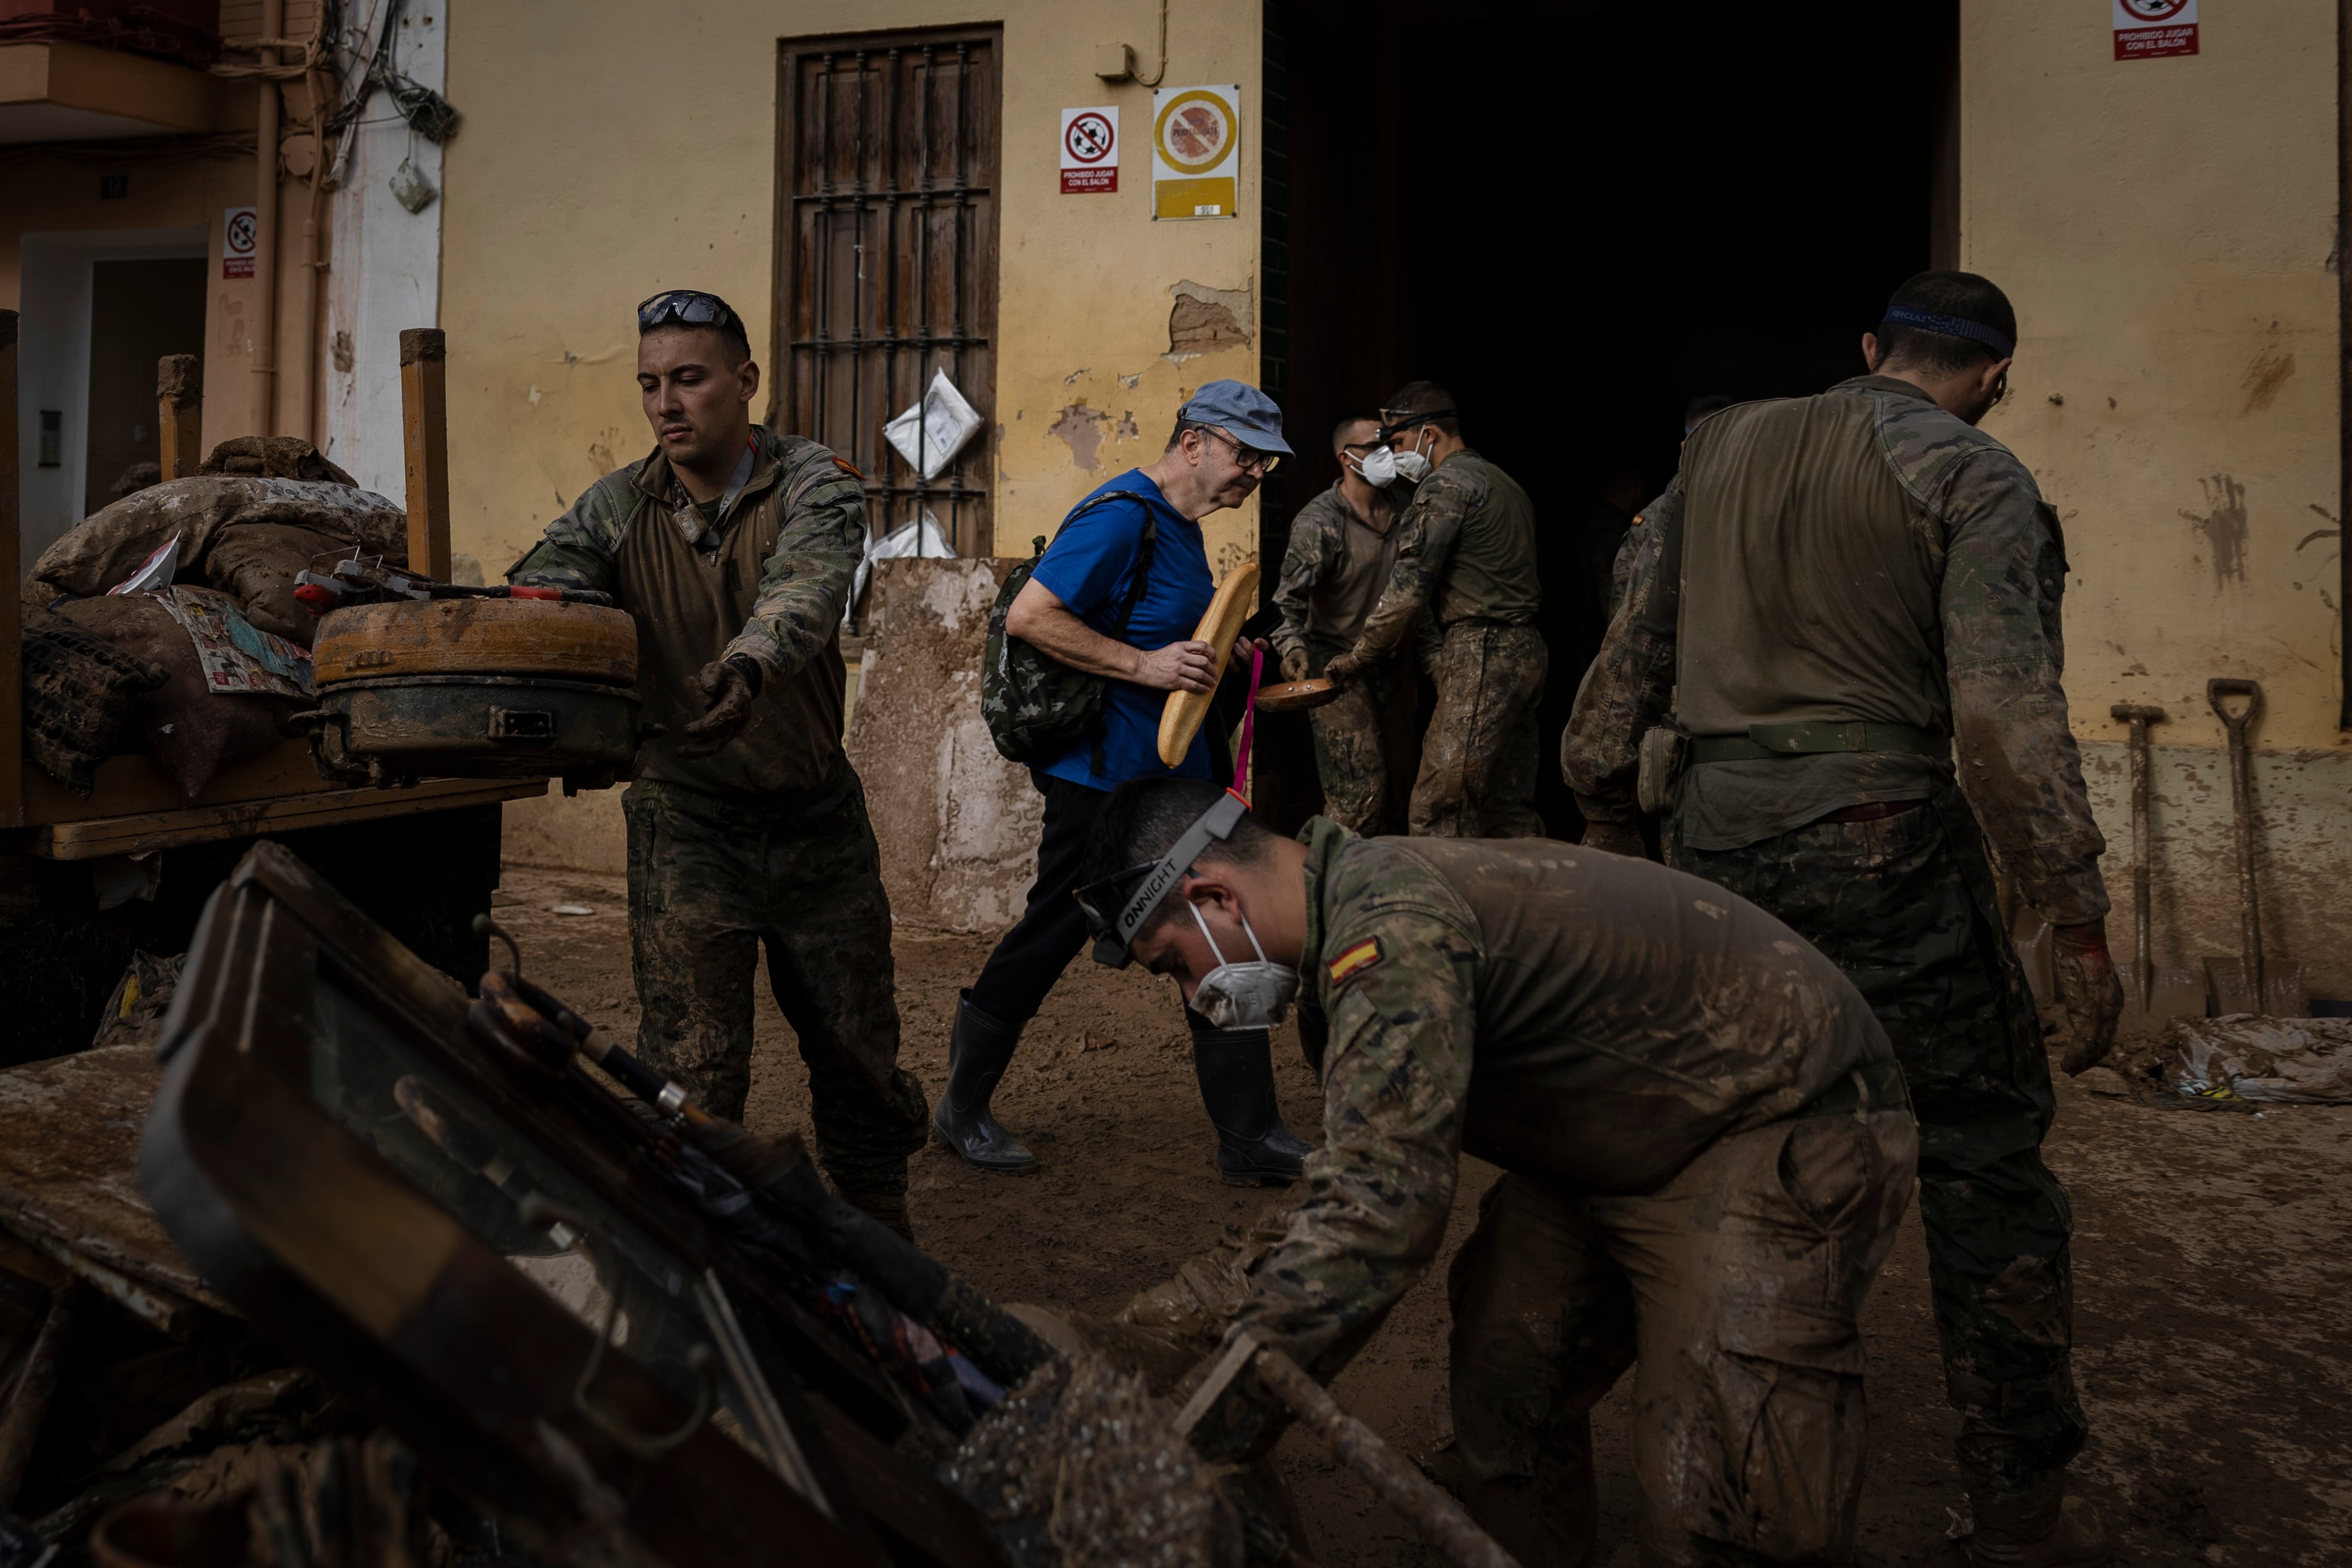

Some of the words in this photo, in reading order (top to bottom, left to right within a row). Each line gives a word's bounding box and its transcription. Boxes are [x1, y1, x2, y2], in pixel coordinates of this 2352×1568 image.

[2118, 30, 2163, 41] PROHIBIDO
[2165, 28, 2194, 38] JUGAR
[2126, 41, 2145, 51] CON
[2145, 40, 2157, 49] EL
[2157, 37, 2186, 48] BALÓN
[1063, 171, 1094, 179] PROHIBIDO
[1095, 169, 1115, 177] JUGAR
[1089, 177, 1110, 185] BALÓN
[1891, 310, 1927, 323] FORCLAZ
[1124, 858, 1177, 929] ONNIGHT
